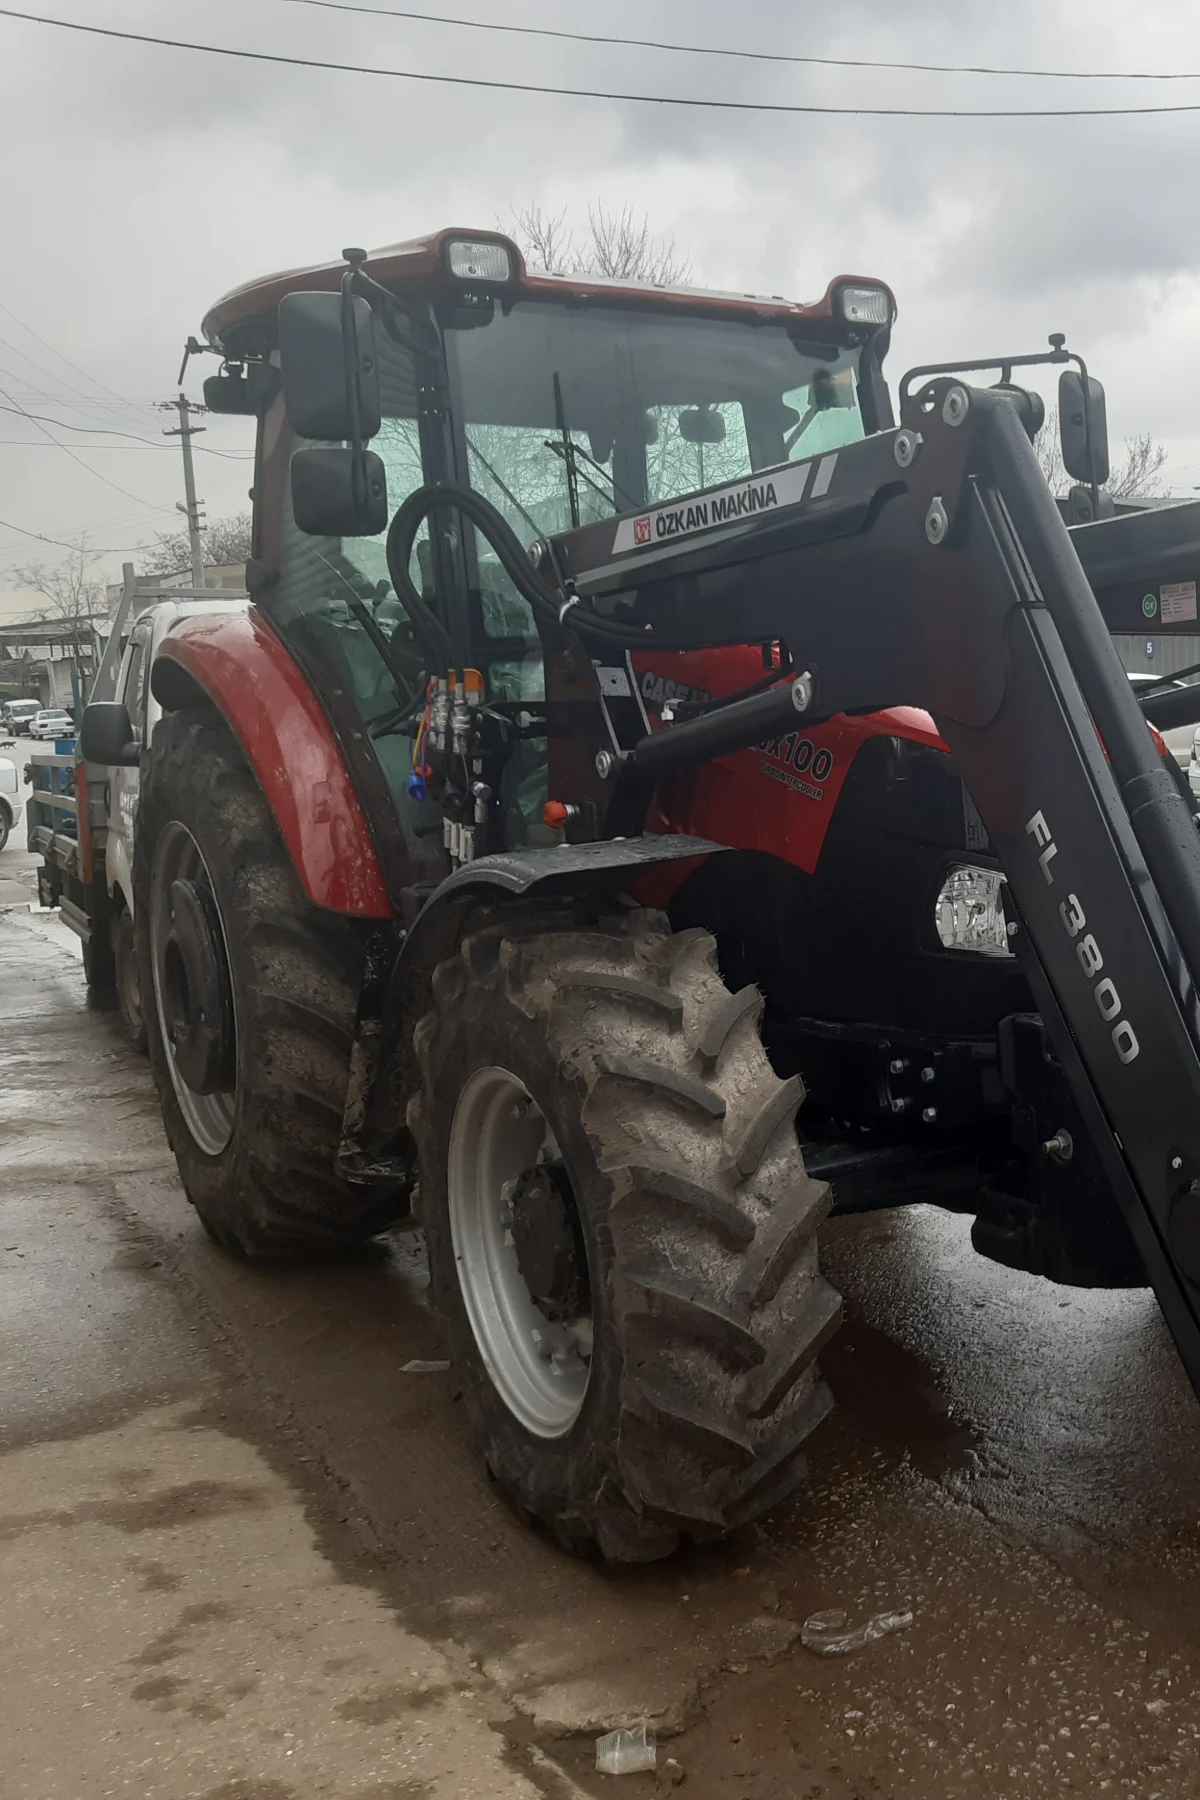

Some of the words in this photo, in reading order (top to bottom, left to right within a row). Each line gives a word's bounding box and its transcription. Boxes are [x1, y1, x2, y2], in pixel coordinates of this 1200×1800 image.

[656, 503, 709, 537] ÖZKAN
[712, 483, 779, 523] MAKİNA
[1146, 642, 1153, 654] 5
[1024, 808, 1058, 886] FL
[1058, 893, 1140, 1065] 3800
